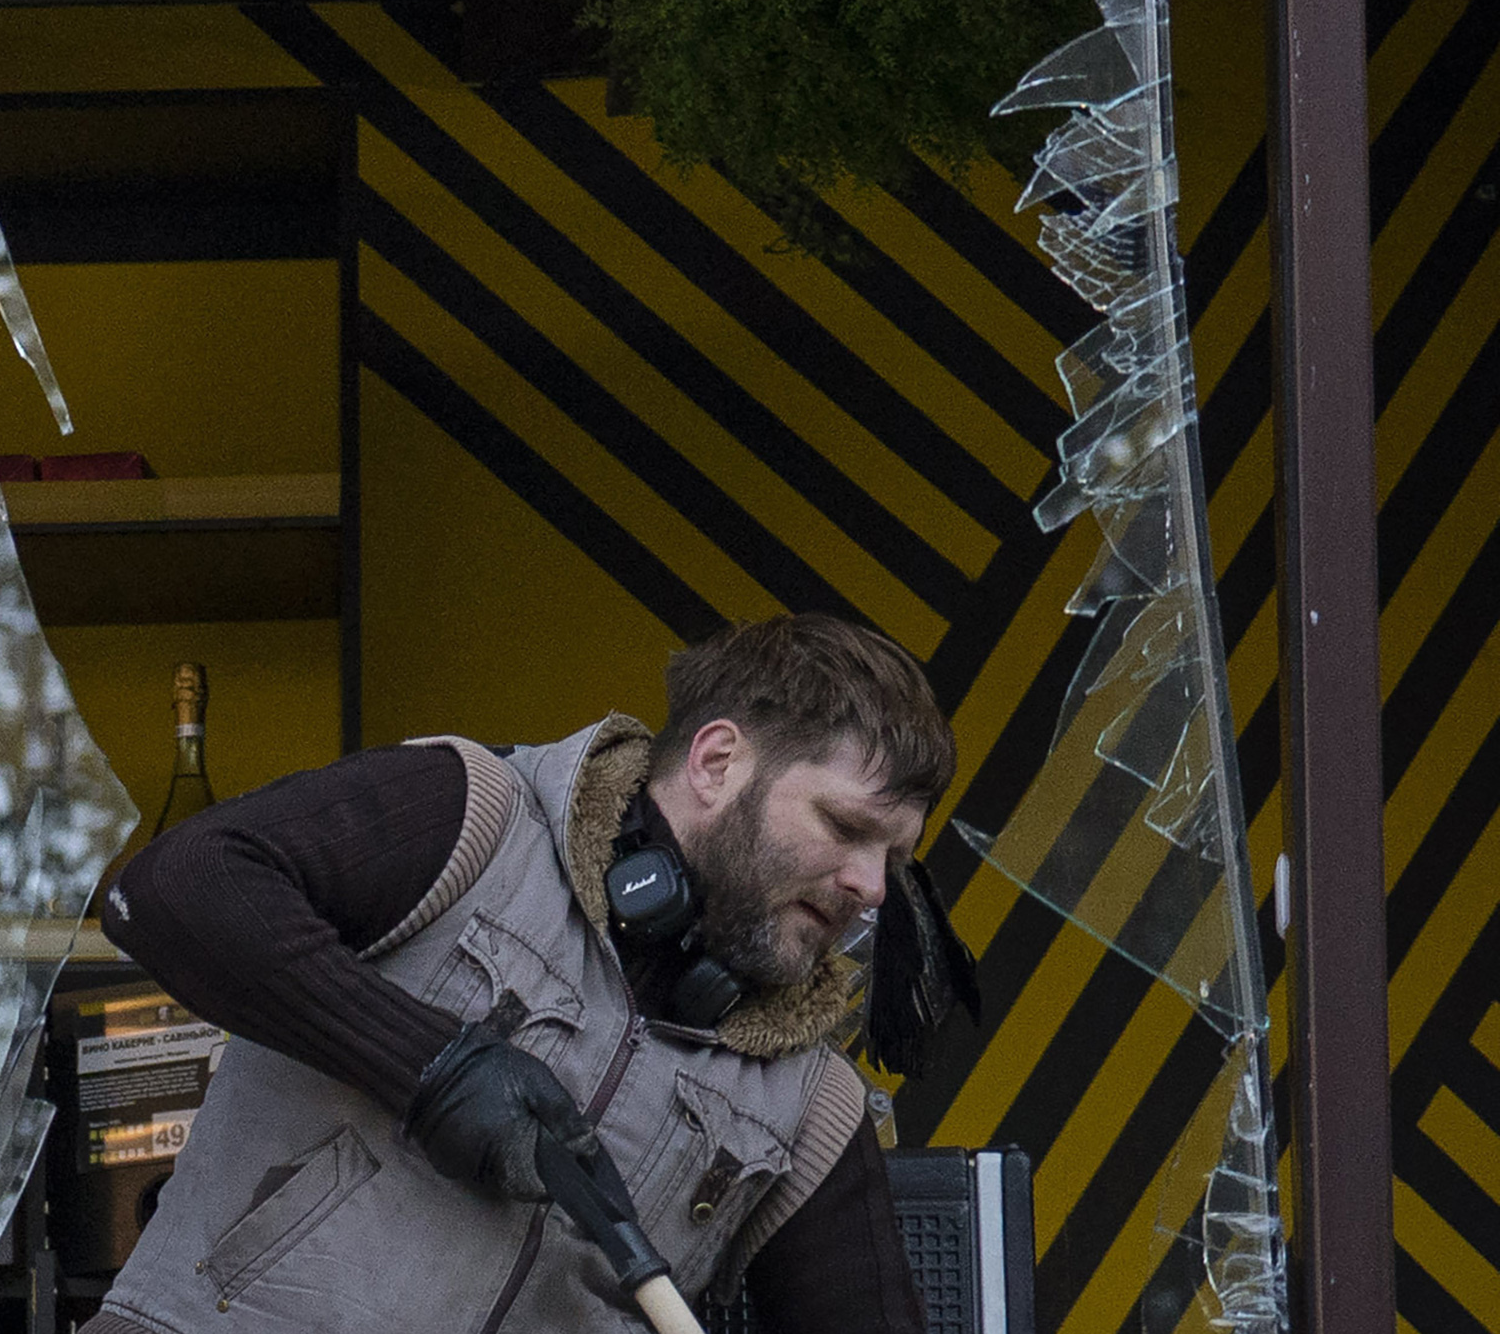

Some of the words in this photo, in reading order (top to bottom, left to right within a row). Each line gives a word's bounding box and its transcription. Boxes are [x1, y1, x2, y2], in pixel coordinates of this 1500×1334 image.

[82, 1042, 109, 1055] ВИНО
[111, 1035, 154, 1050] КАБЕРНЕ
[155, 1124, 185, 1148] 49
